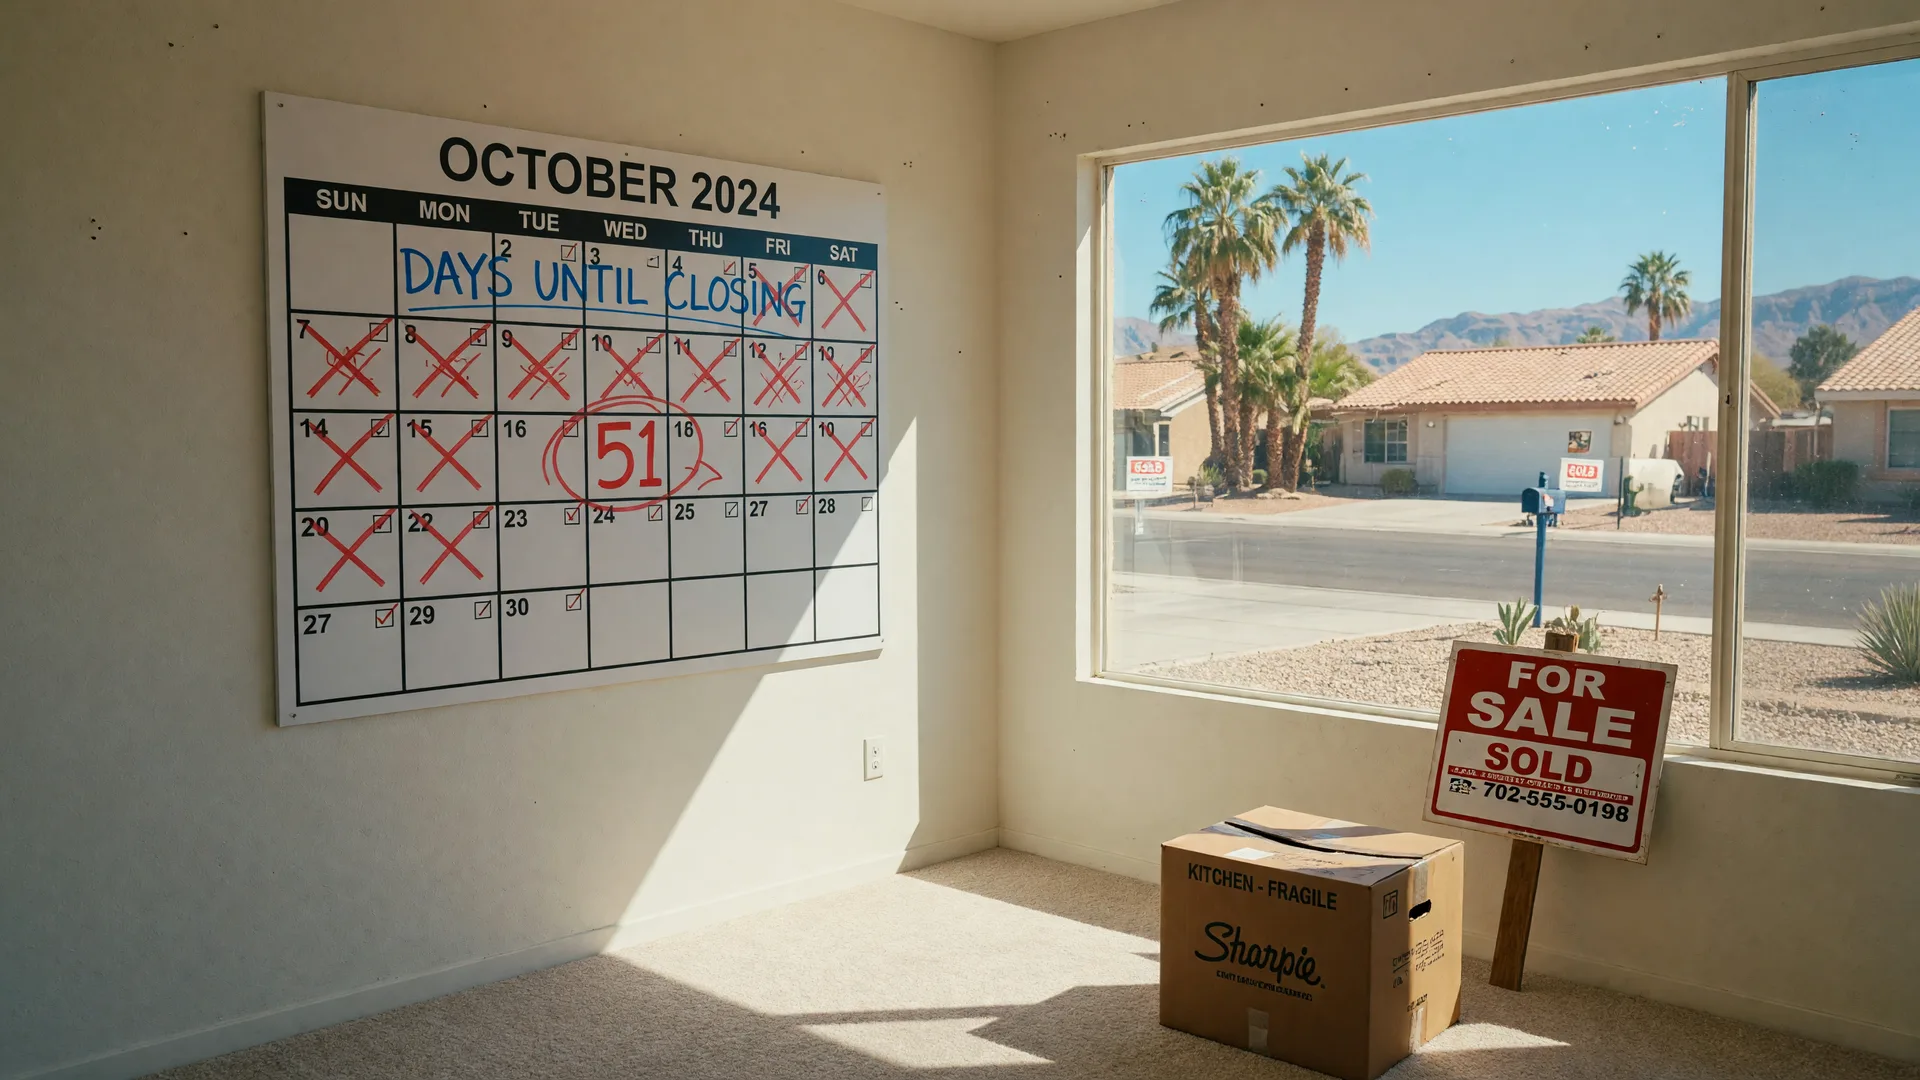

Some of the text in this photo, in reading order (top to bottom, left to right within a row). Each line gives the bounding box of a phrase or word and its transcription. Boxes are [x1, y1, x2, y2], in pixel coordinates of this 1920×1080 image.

[439, 136, 780, 219] OCTOBER 2024
[316, 188, 858, 262] SUN MON TUE WED THU FRI SAT
[500, 238, 825, 285] 2 3 4 5 6
[400, 247, 806, 323] DAYS UNTIL CLOSING
[297, 319, 310, 340] 7
[405, 324, 417, 344] 8
[501, 329, 513, 348] 9
[591, 334, 612, 352] 10
[673, 338, 692, 355] 11
[749, 343, 766, 358] 12
[300, 418, 527, 438] 14 15 16
[749, 421, 767, 437] 16
[597, 420, 662, 489] 51
[407, 512, 433, 532] 22
[503, 509, 528, 528] 23
[592, 505, 615, 524] 24
[675, 503, 695, 520] 25
[749, 501, 768, 517] 27
[818, 498, 836, 514] 28
[303, 597, 529, 635] 27 29 30
[1507, 661, 1606, 700] FOR
[1467, 691, 1636, 749] SALE
[1484, 742, 1593, 784] SOLD
[1483, 781, 1629, 822] 702-555-0198
[1188, 863, 1253, 893] KITCHEN
[1268, 880, 1338, 910] FRAGILE
